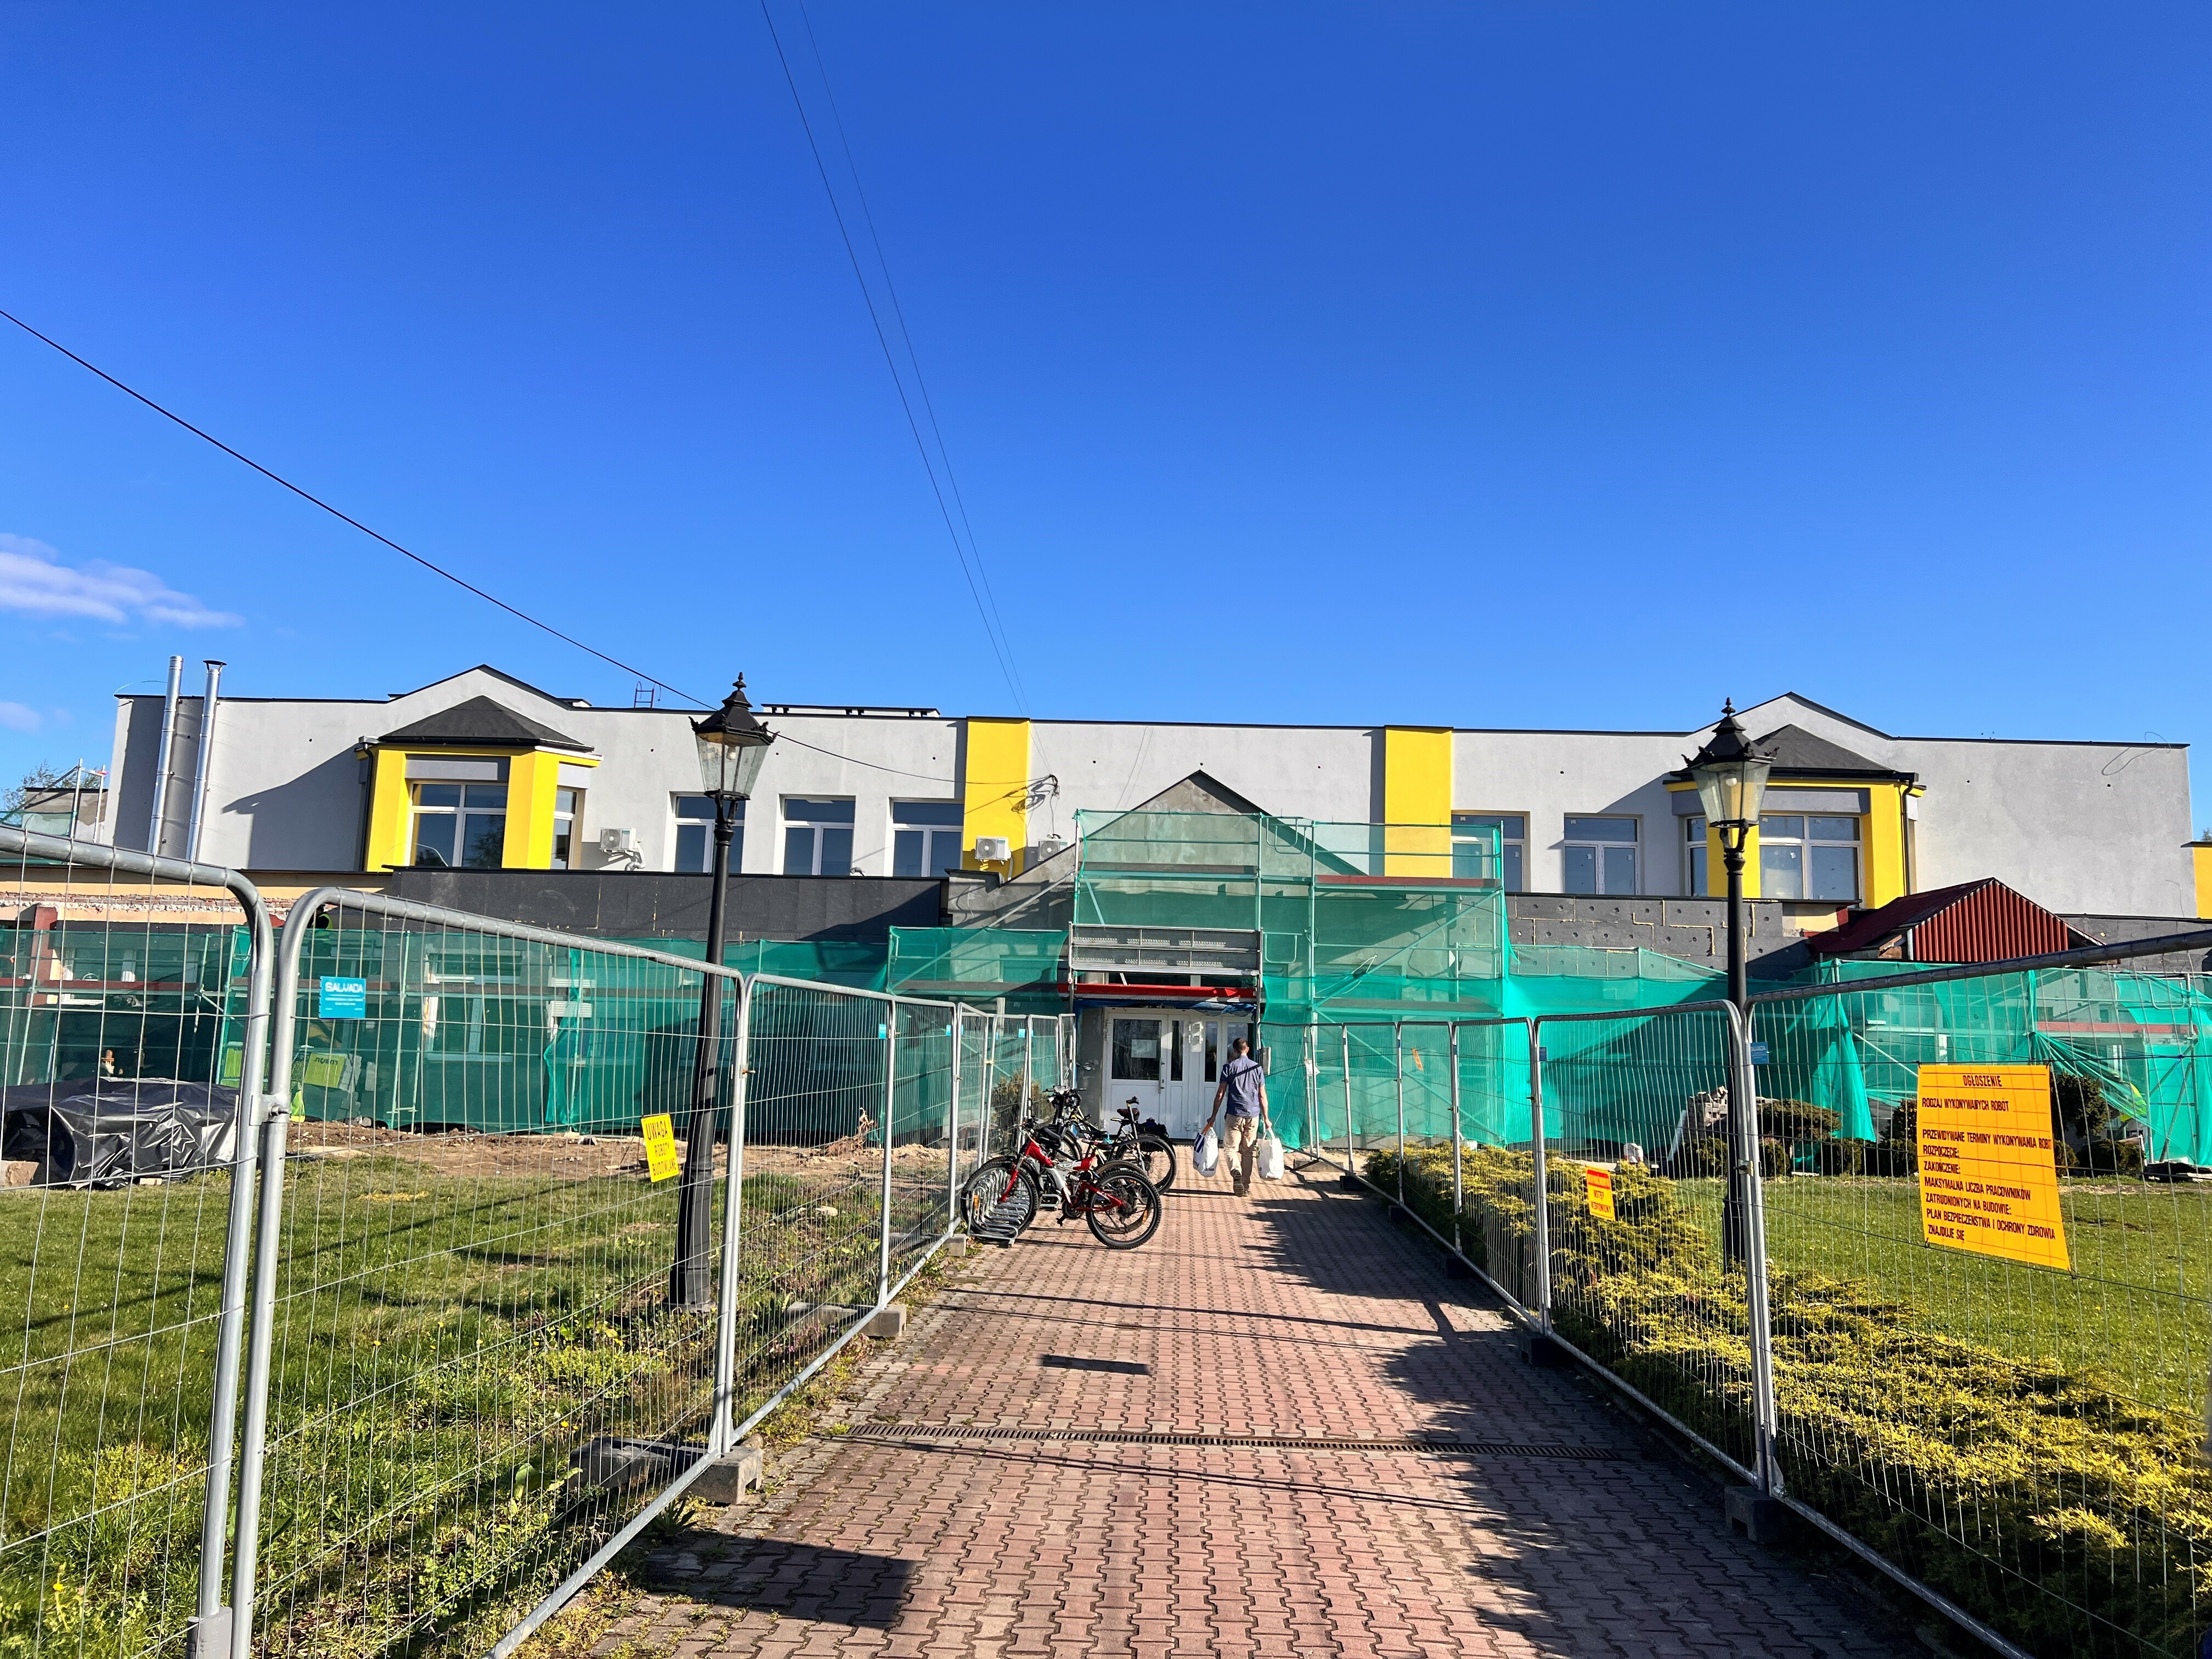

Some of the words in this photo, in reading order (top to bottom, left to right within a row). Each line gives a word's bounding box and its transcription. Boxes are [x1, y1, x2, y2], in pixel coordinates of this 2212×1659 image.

[1963, 1075, 2002, 1087] OGŁOSZENIE
[1922, 1098, 1942, 1108] RODZAJ
[1945, 1098, 1989, 1110] WYKONYWANYCH
[1991, 1098, 2008, 1111] ROBÓT
[1922, 1129, 1965, 1142] PRZEWIDYWANE
[1967, 1132, 1990, 1144] TERMINY
[1993, 1135, 2037, 1148] WYKONYWANIA
[1925, 1176, 1963, 1191] MAKSYMALNA
[1966, 1182, 1984, 1193] LICZBA
[1986, 1184, 2030, 1200] PRACOWNIKÓW
[1926, 1193, 1971, 1207] ZATRUDNIONYCH
[1973, 1200, 1981, 1210] NA
[1983, 1201, 2011, 1215] BUDOWIE:
[1926, 1208, 1942, 1220] PLAN
[1944, 1211, 1990, 1228] BEZPIECZEŃSTWA
[1993, 1219, 1995, 1229] I
[1997, 1219, 2025, 1234] OCHRONY
[2027, 1224, 2056, 1240] ZDROWIA
[1928, 1224, 1954, 1239] ZNAJDUJE
